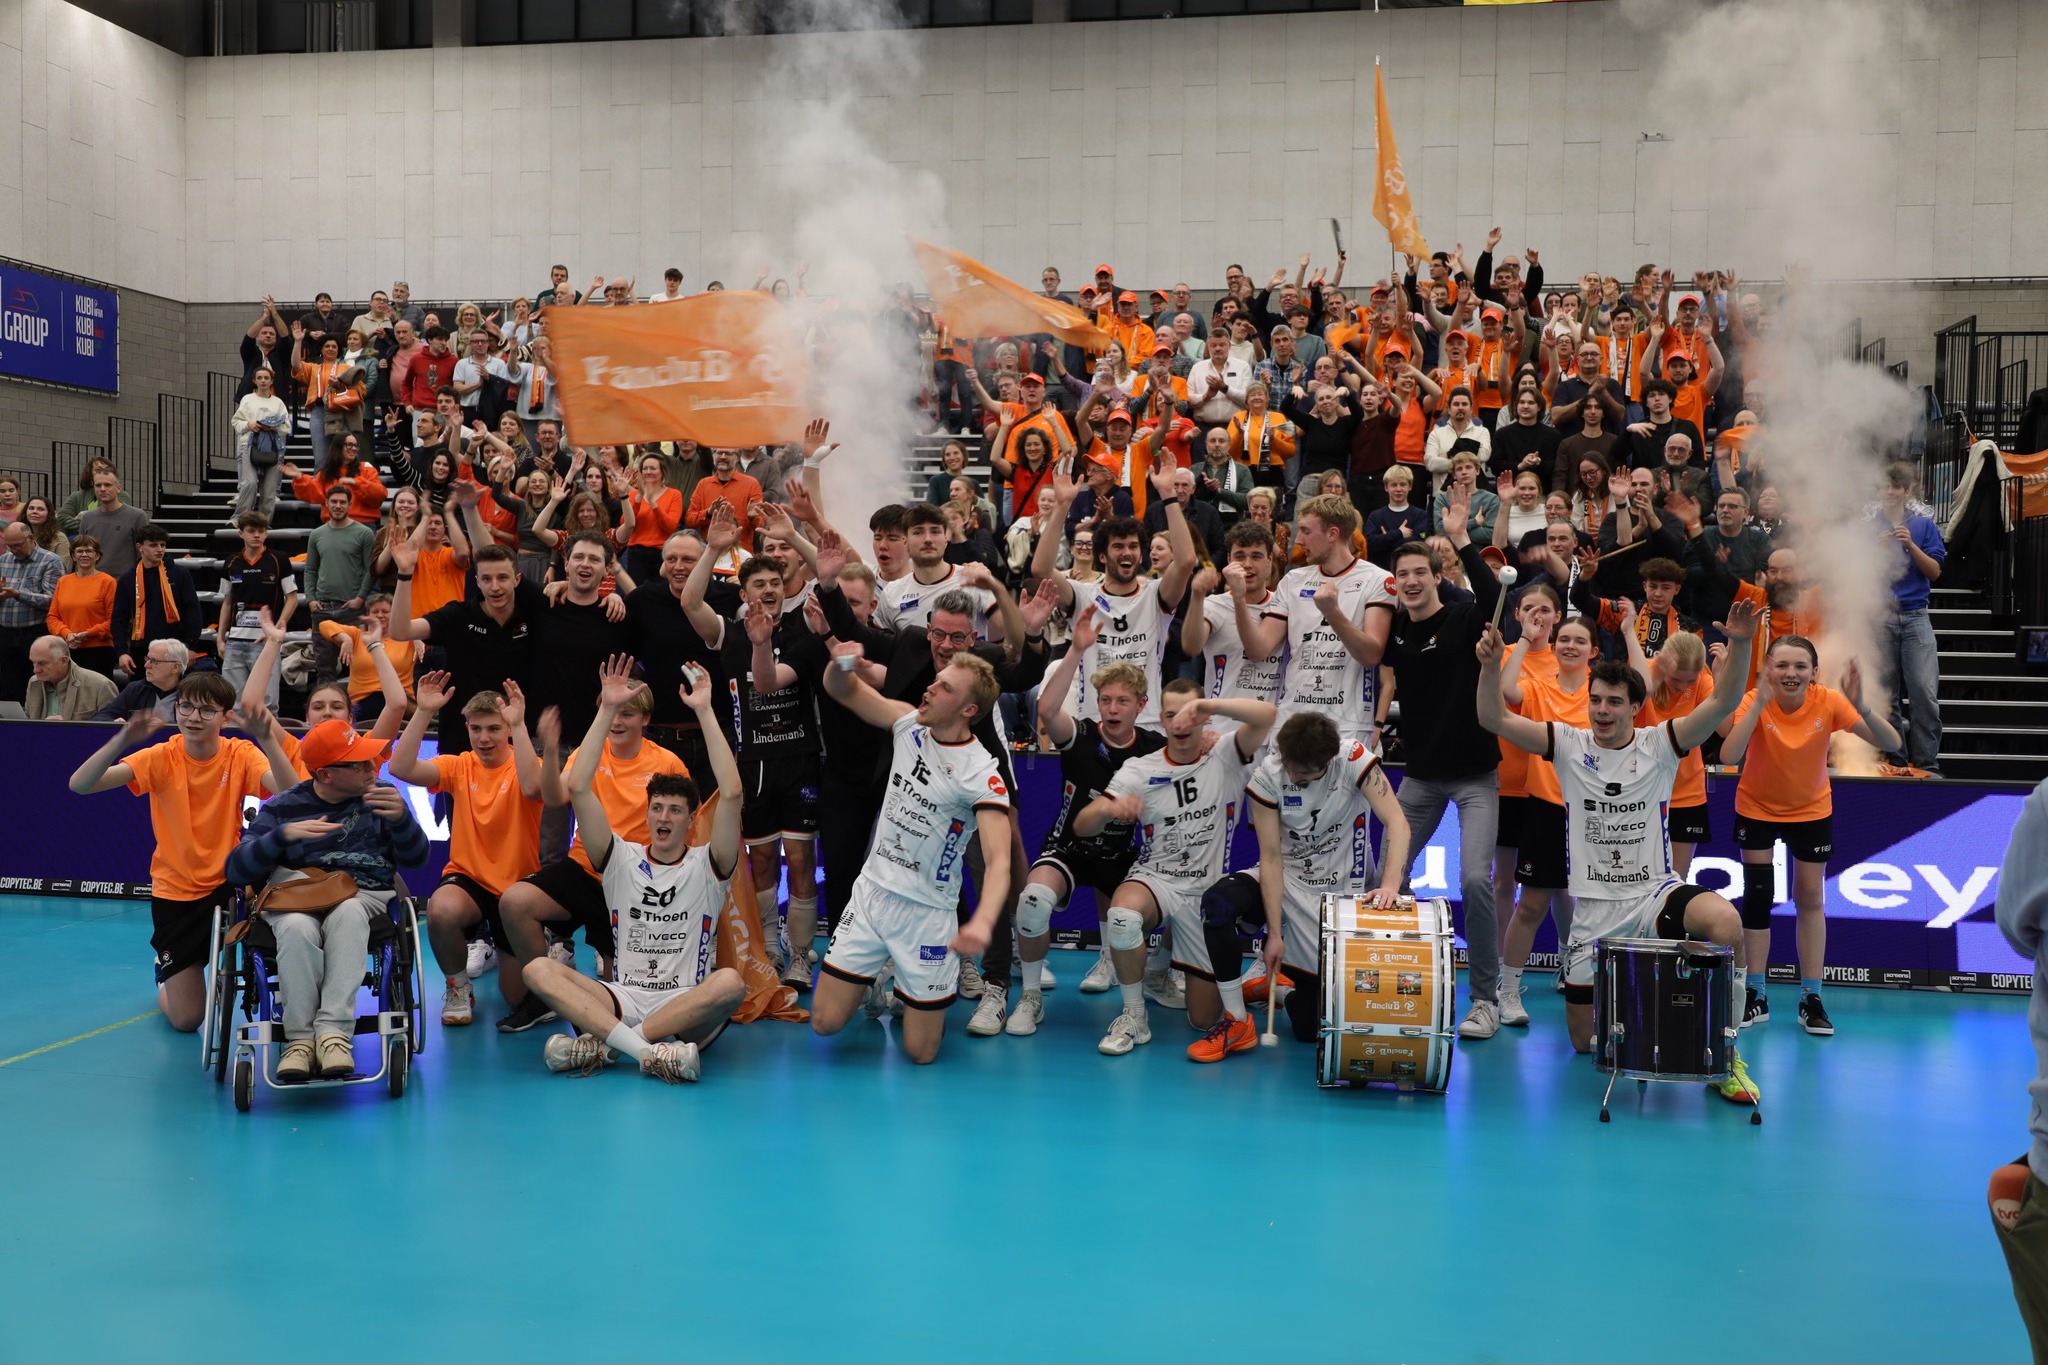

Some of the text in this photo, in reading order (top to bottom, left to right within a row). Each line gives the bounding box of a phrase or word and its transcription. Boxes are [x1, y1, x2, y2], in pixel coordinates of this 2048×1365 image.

[76, 294, 94, 316] KUBI
[4, 310, 49, 347] GROUP
[76, 315, 94, 337] KUBI
[76, 336, 95, 357] KUBI
[1648, 618, 1662, 643] 6
[1110, 633, 1147, 647] Thoen
[1115, 651, 1147, 660] IVECO
[1316, 651, 1346, 659] IVECO
[755, 700, 800, 711] CAMMAERT
[1173, 777, 1198, 808] 16
[1599, 801, 1646, 814] Thoen
[1301, 823, 1342, 843] Then
[1607, 822, 1646, 832] IVECO
[1592, 837, 1646, 846] CAMMAERT
[0, 877, 43, 890] COPYTEC.BE
[80, 881, 124, 895] COPYTEC.BE
[642, 885, 677, 908] 20
[644, 911, 688, 923] Thoen
[649, 932, 687, 941] IVECO
[633, 947, 684, 955] CAMMAERT
[1991, 974, 2034, 989] COPYTE
